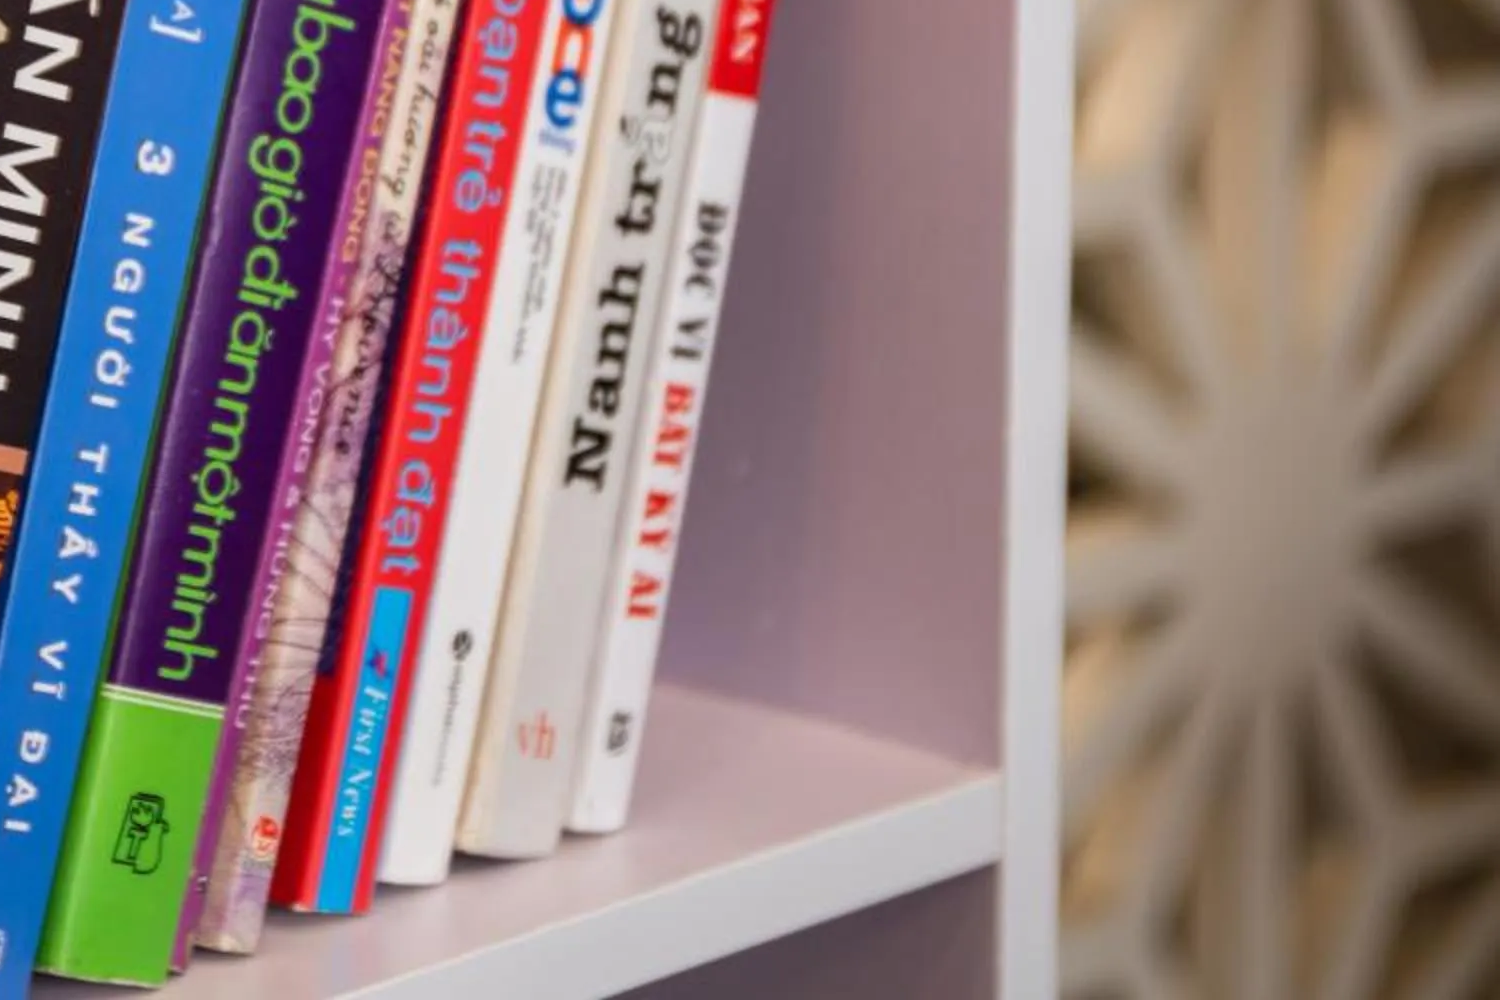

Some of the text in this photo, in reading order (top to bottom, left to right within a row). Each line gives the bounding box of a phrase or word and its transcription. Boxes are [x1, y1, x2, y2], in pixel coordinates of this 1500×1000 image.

[275, 1, 355, 135] bao
[137, 139, 176, 177] 3
[249, 129, 305, 242] giờ
[453, 111, 509, 213] trẻ
[233, 240, 298, 309] đi
[564, 4, 704, 494] Nanh trắng
[90, 211, 156, 411] NGƯỜI
[214, 305, 277, 400] ăn
[323, 297, 347, 349] HY
[406, 238, 483, 442] thành
[192, 397, 252, 526] một
[378, 461, 437, 588] đạt
[32, 640, 69, 700] VĨ
[3, 729, 51, 833] ĐẠI
[338, 686, 388, 838] First News
